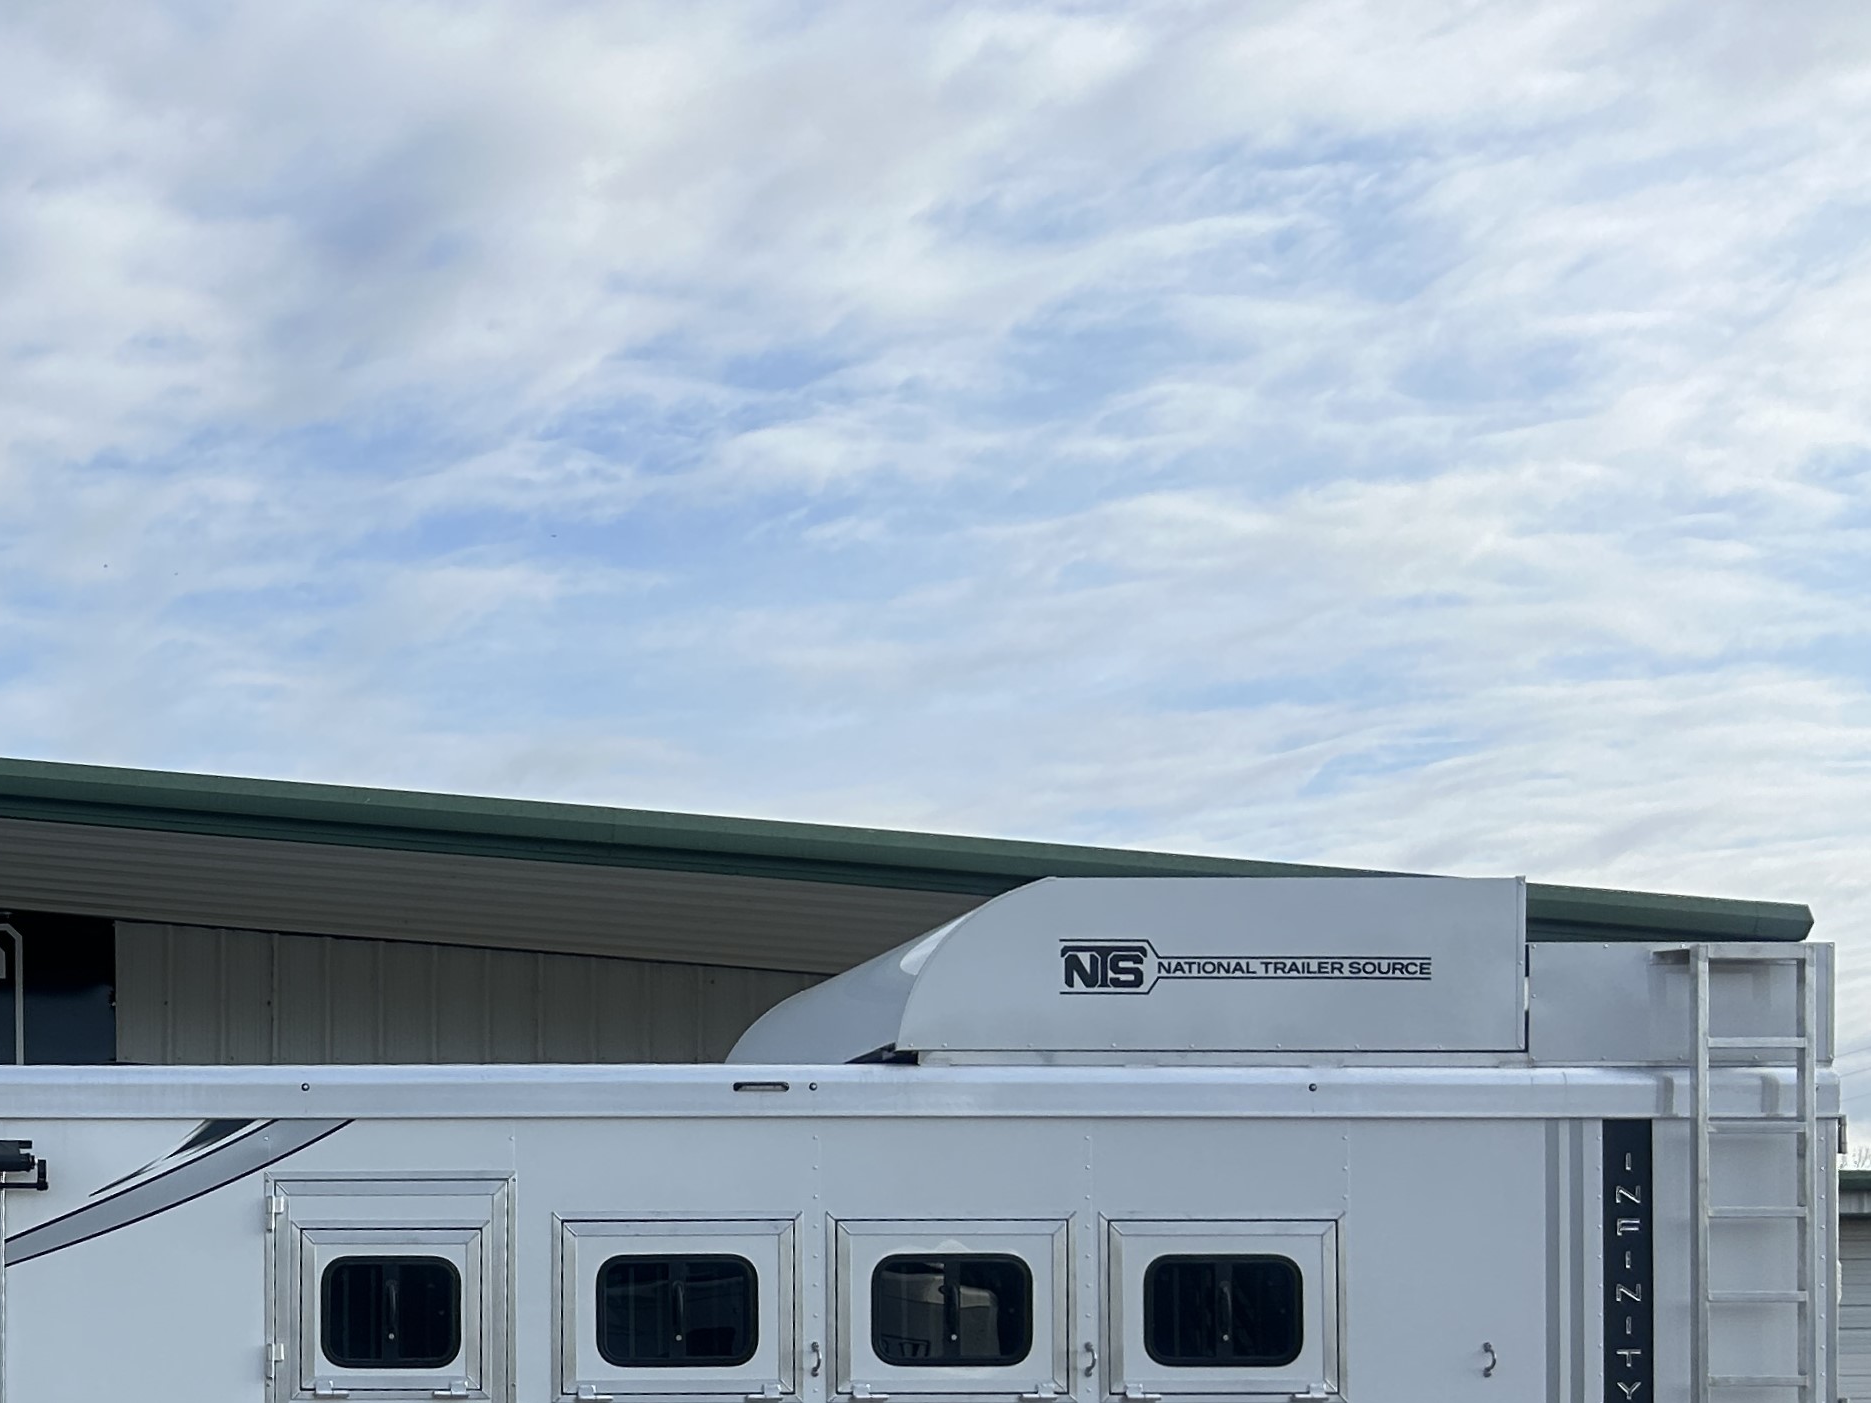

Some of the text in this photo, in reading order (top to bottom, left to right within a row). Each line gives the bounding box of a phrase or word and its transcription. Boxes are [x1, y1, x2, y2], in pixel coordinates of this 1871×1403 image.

[1060, 945, 1147, 989] NTS
[1157, 961, 1432, 975] NATIONAL TRAILER SOURCE
[1615, 1152, 1643, 1400] INFINITY
